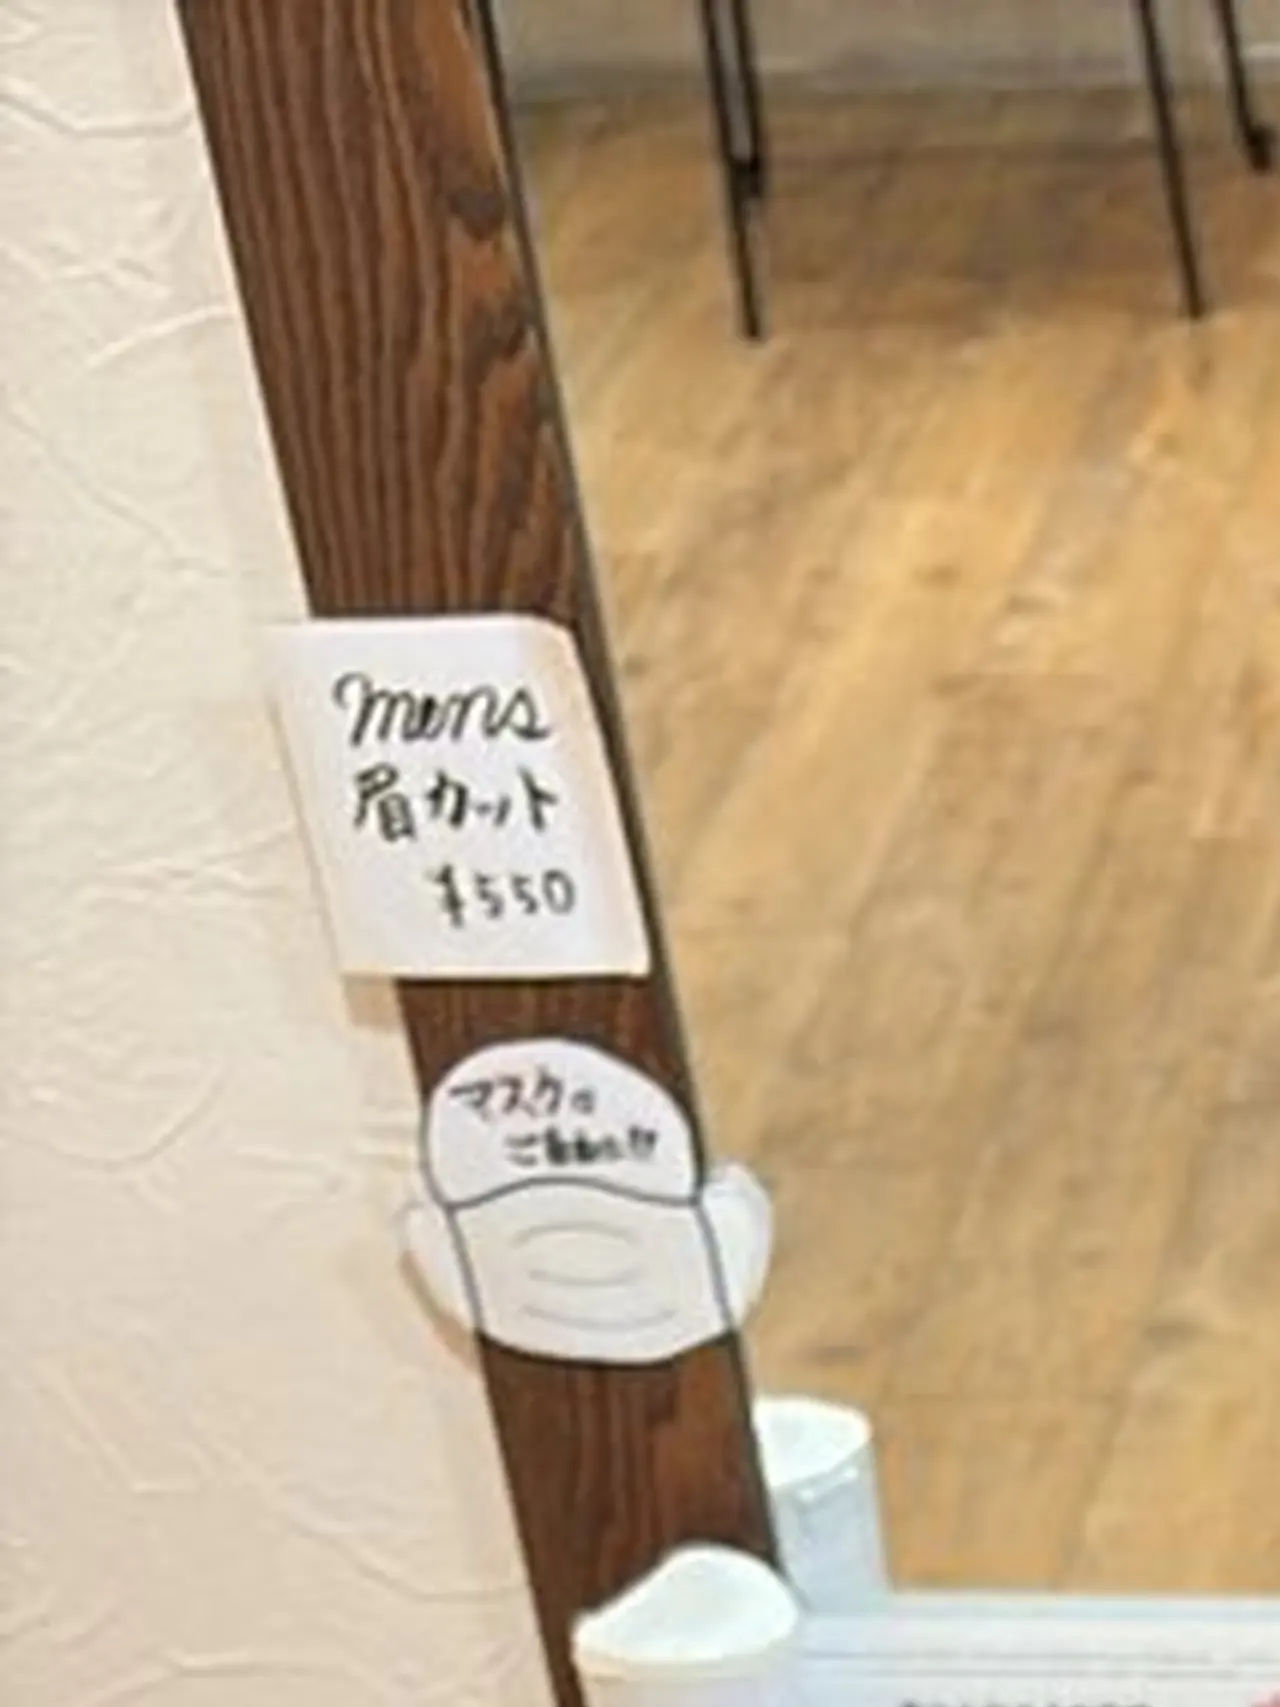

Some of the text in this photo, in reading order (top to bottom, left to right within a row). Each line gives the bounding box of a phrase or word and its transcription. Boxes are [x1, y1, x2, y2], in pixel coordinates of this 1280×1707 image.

[354, 765, 560, 844] 眉カット
[426, 866, 577, 929] ¥550
